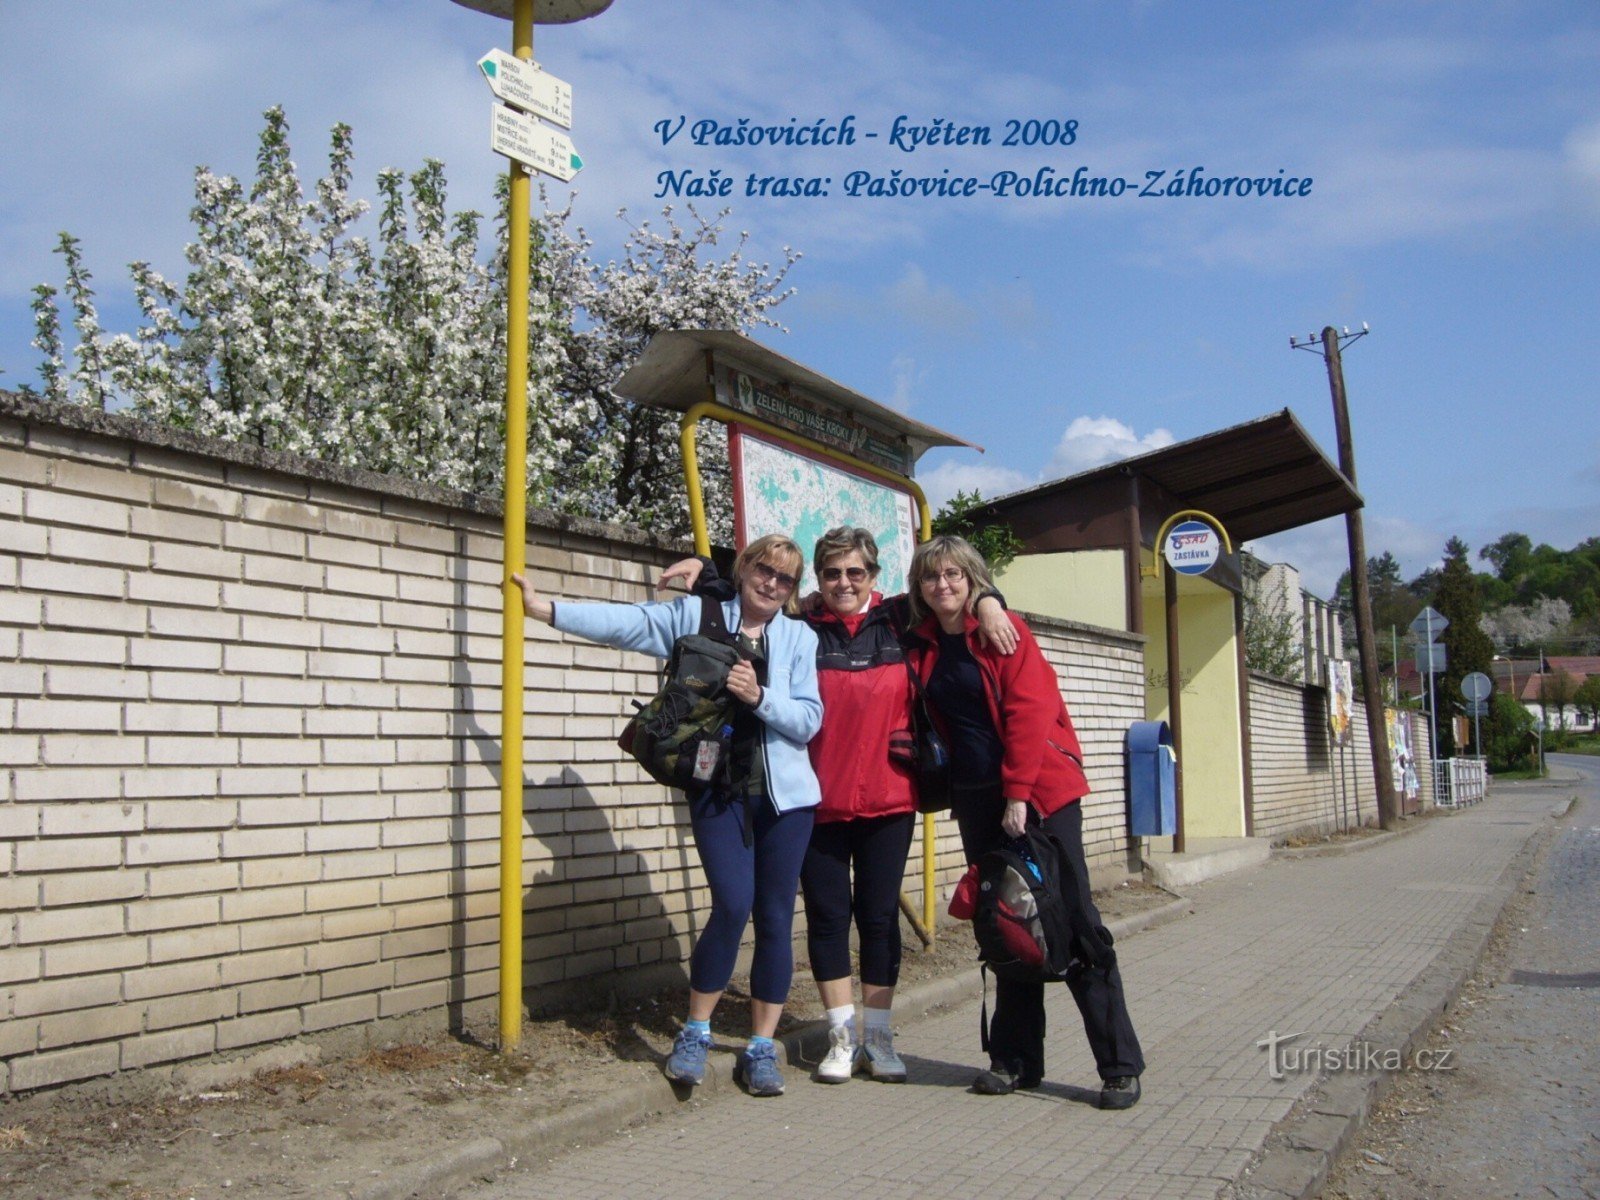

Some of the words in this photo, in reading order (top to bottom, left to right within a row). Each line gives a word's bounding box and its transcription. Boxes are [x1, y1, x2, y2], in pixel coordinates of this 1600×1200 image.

[788, 406, 804, 424] PRO
[805, 412, 826, 431] VAŠE
[826, 421, 850, 441] KROKY
[1174, 549, 1210, 561] ZASTÁVKA
